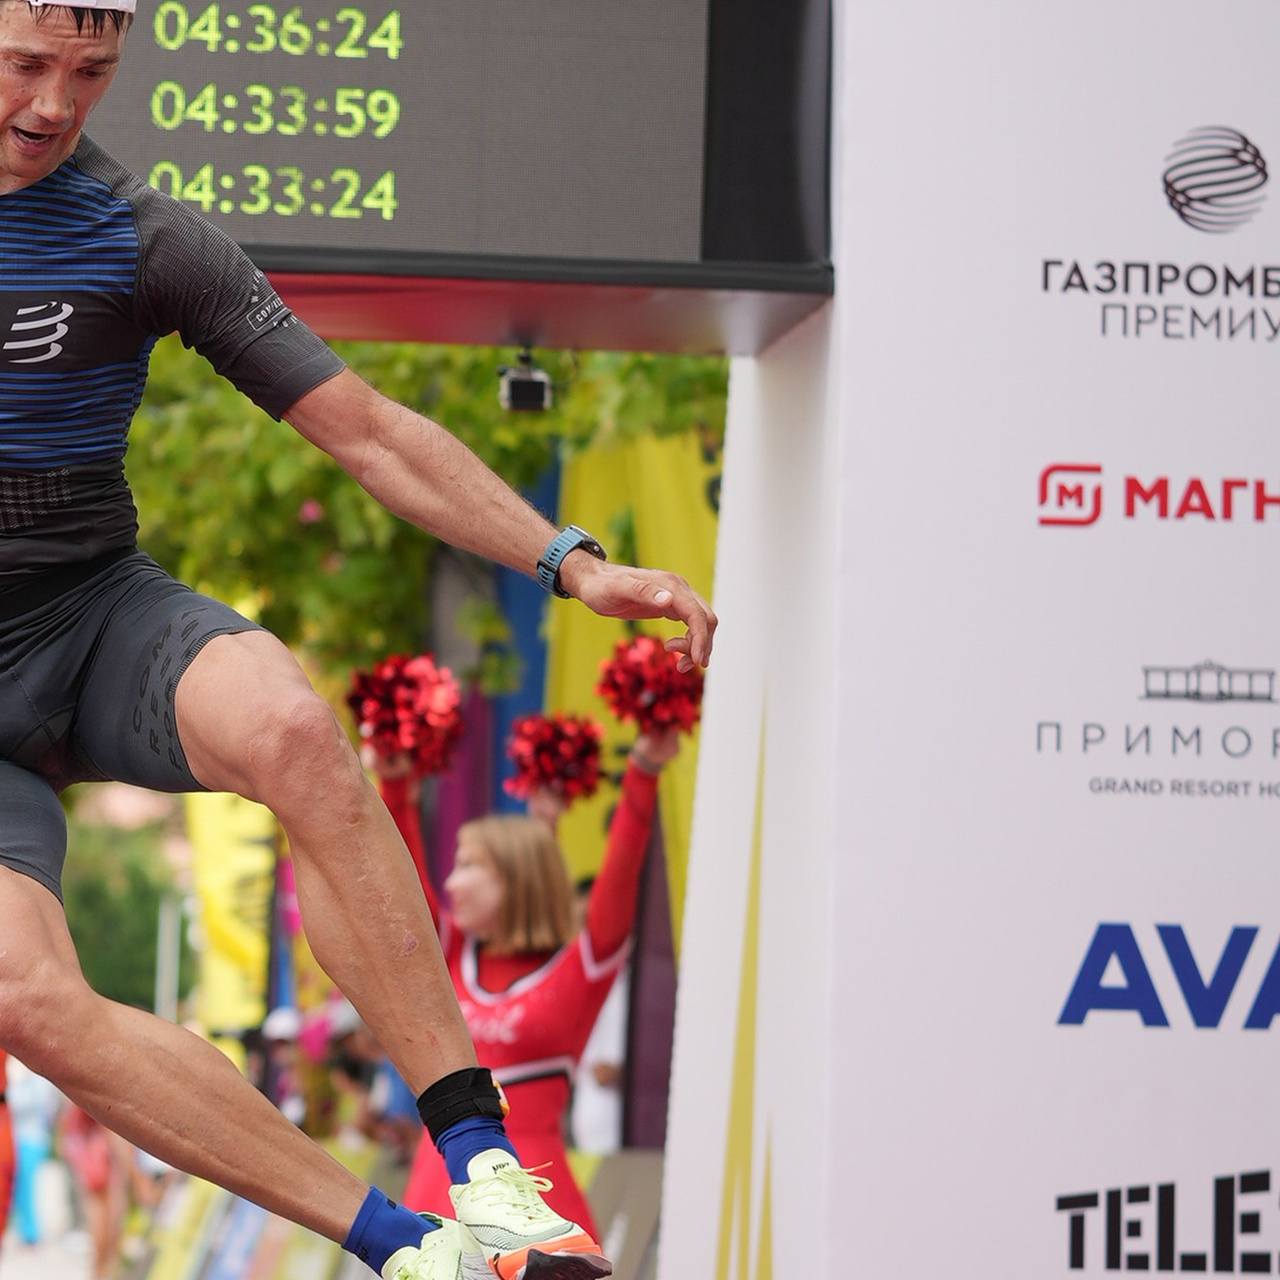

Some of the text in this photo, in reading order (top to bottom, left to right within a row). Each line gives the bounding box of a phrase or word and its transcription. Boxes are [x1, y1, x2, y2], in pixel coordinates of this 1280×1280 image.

[152, 0, 405, 60] 04:36:24
[149, 79, 402, 139] 04:33:59
[148, 159, 400, 221] 04:33:24
[1125, 476, 1280, 521] МАГН
[1088, 777, 1163, 795] GRAND
[1170, 779, 1252, 798] RESORT
[1056, 1170, 1280, 1274] TELE
